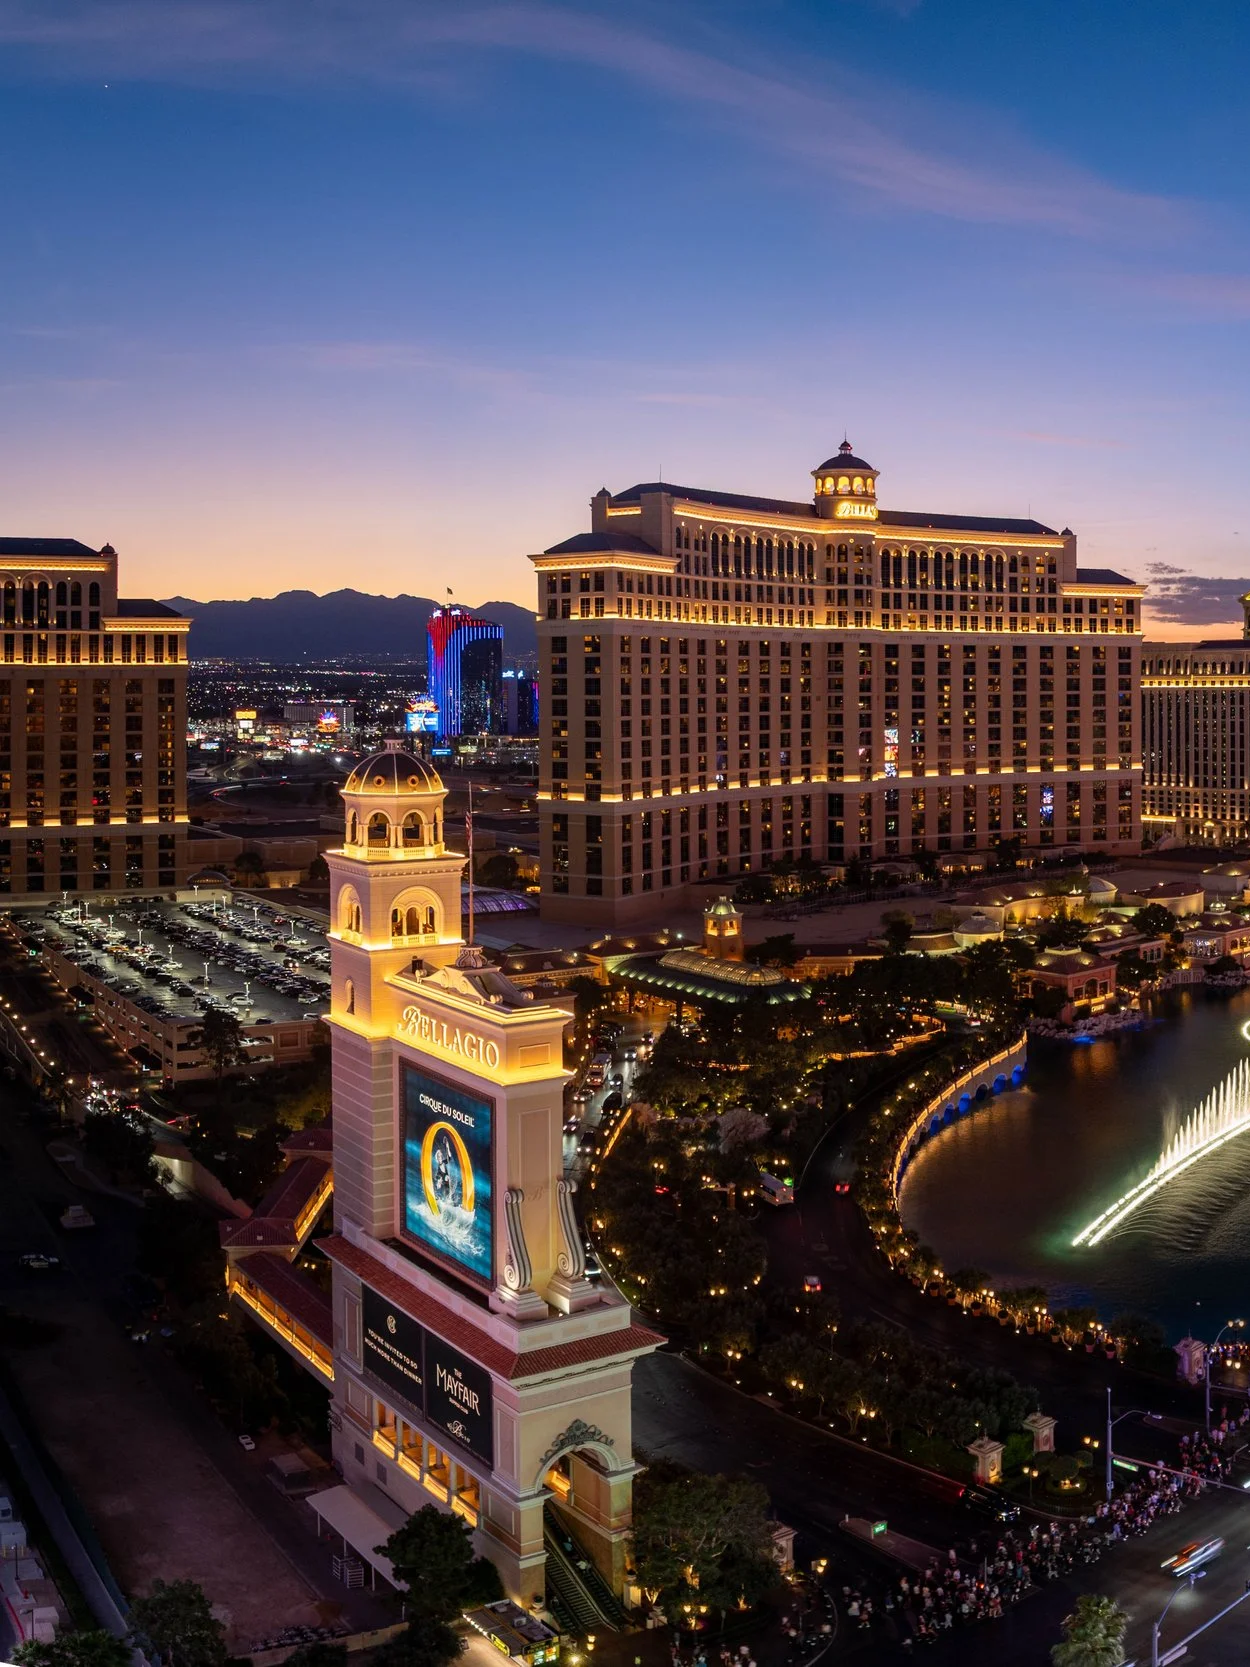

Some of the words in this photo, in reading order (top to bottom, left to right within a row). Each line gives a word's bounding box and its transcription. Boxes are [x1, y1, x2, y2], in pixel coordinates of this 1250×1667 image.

[397, 1005, 500, 1069] BELLAGIO
[419, 1093, 442, 1113] CIRQUE
[442, 1103, 452, 1116] DU
[452, 1109, 475, 1128] SOLEIL
[364, 1337, 377, 1350] MUCH
[377, 1348, 390, 1361] MORE
[390, 1357, 404, 1372] THAN
[403, 1367, 422, 1385] DINNER
[384, 1342, 403, 1359] INVITED
[403, 1356, 410, 1365] TO
[410, 1360, 418, 1370] SO
[453, 1367, 463, 1380] THE
[436, 1363, 481, 1417] MAYFAIR
